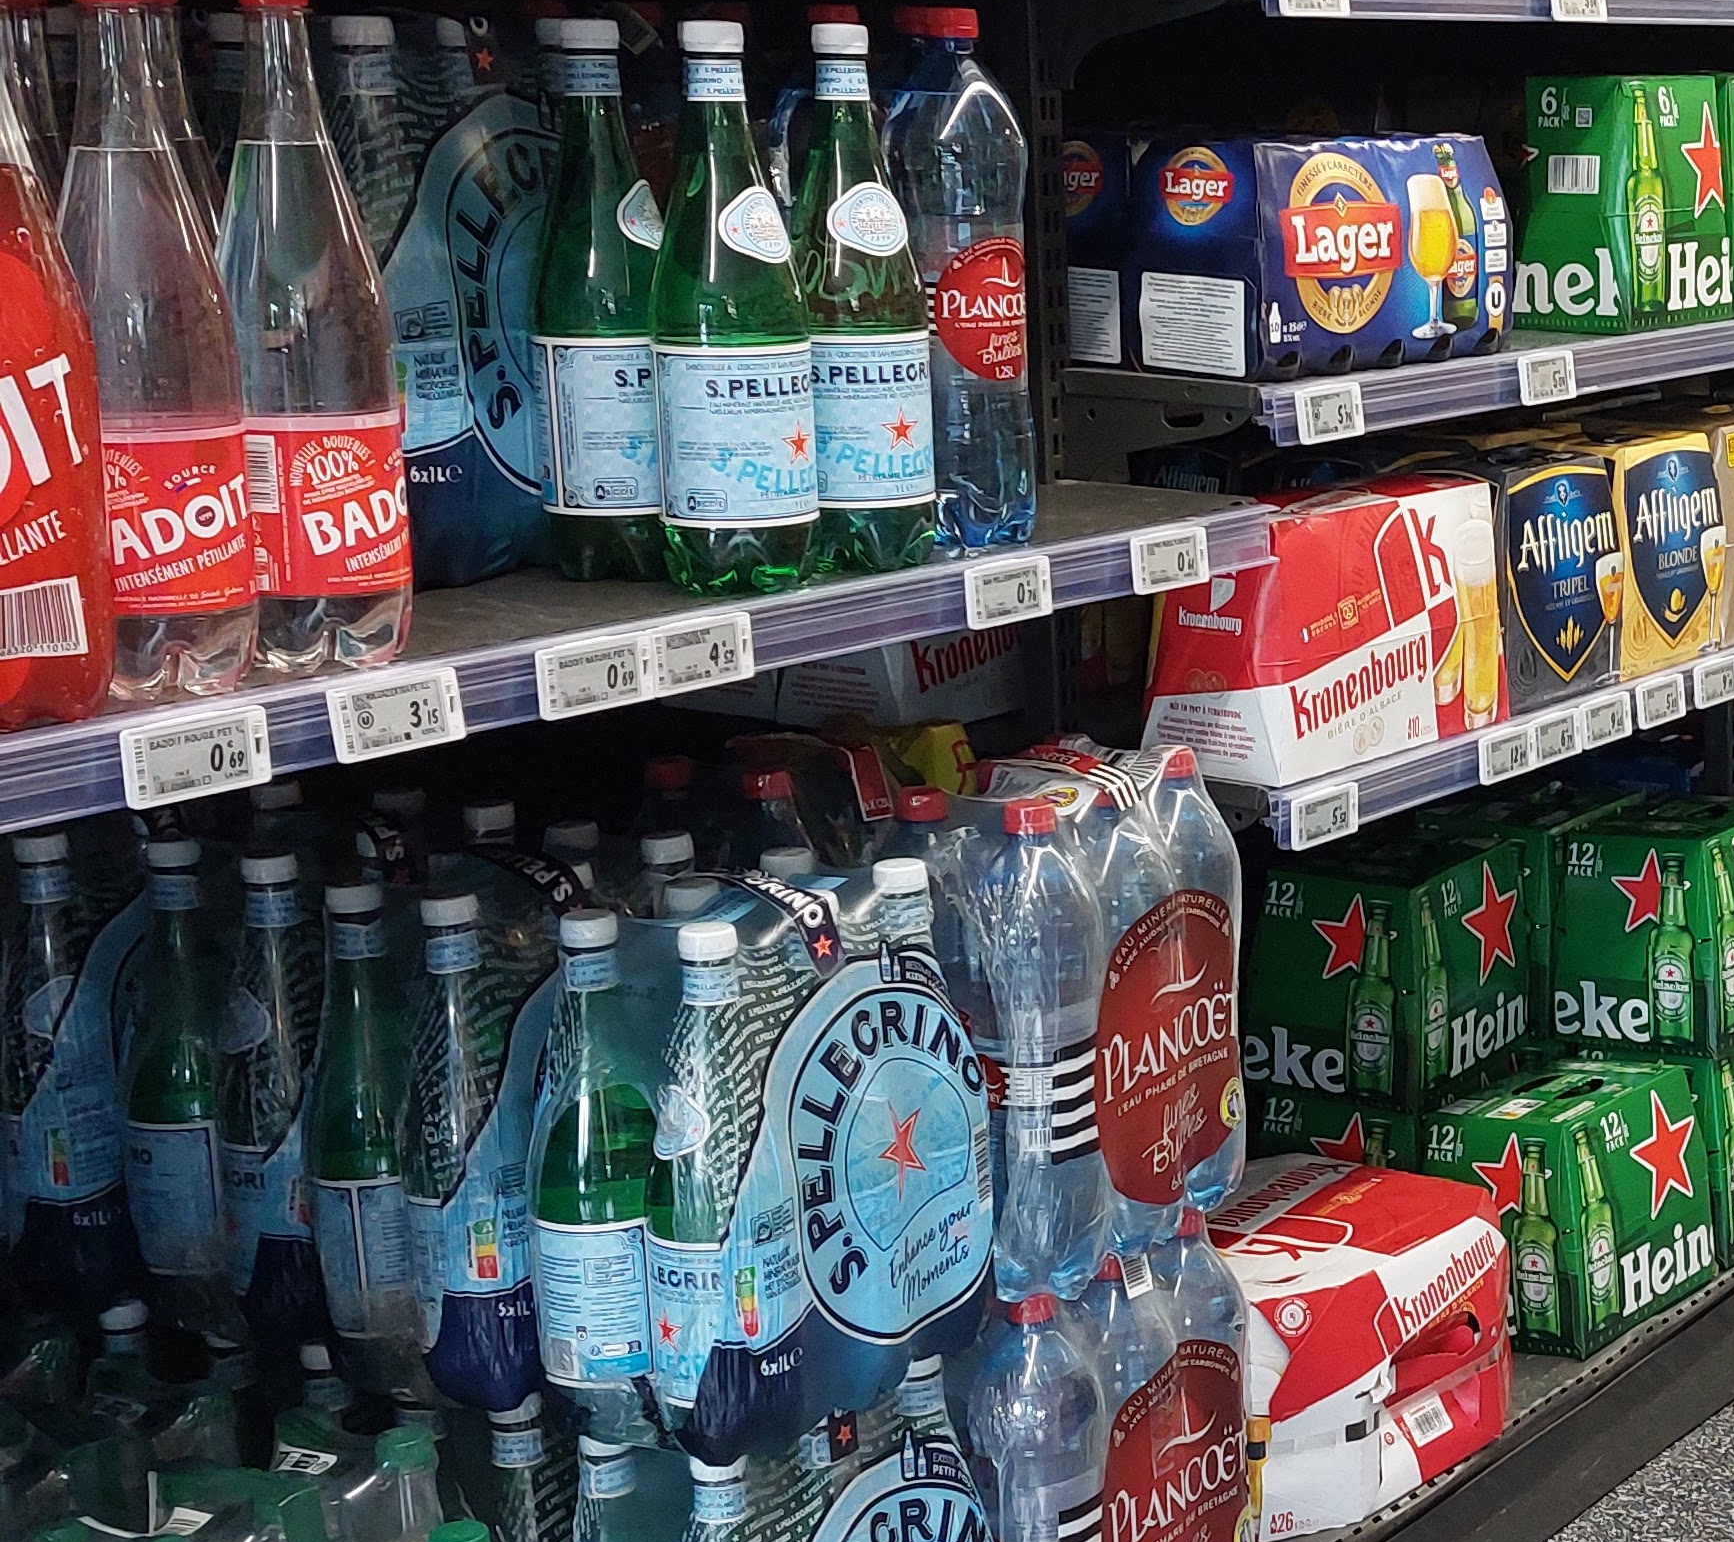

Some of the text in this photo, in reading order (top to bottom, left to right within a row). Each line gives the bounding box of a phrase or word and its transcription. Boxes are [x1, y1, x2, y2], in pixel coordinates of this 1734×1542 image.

[1165, 171, 1229, 200] Lager
[1290, 213, 1394, 272] Lager
[940, 287, 1027, 323] PLANCO
[705, 372, 812, 402] S.PELLEG
[810, 362, 930, 386] S.PELLEGR
[164, 463, 218, 491] SOURCE
[306, 449, 360, 486] 100%
[110, 473, 250, 566] ADOIT
[302, 474, 408, 558] BADO
[1633, 483, 1718, 541] Affligem
[1520, 507, 1615, 575] Affligem
[1657, 547, 1699, 570] BLONDE
[114, 531, 248, 593] INTENSÉMENT PÉTILLANTE
[1551, 575, 1590, 596] TRIPEL
[1178, 606, 1242, 637] Kronenbourg
[1288, 633, 1429, 741] Kronenbourg
[1567, 842, 1596, 866] 12
[1265, 880, 1295, 905] 12
[1101, 977, 1237, 1105] PLANCOËT
[1427, 1124, 1457, 1149] 12
[1426, 1147, 1456, 1163] PACK
[938, 1199, 977, 1252] your
[901, 1239, 973, 1314] Moments
[1393, 1229, 1499, 1343] Kronenbourg
[1275, 1510, 1295, 1534] 26
